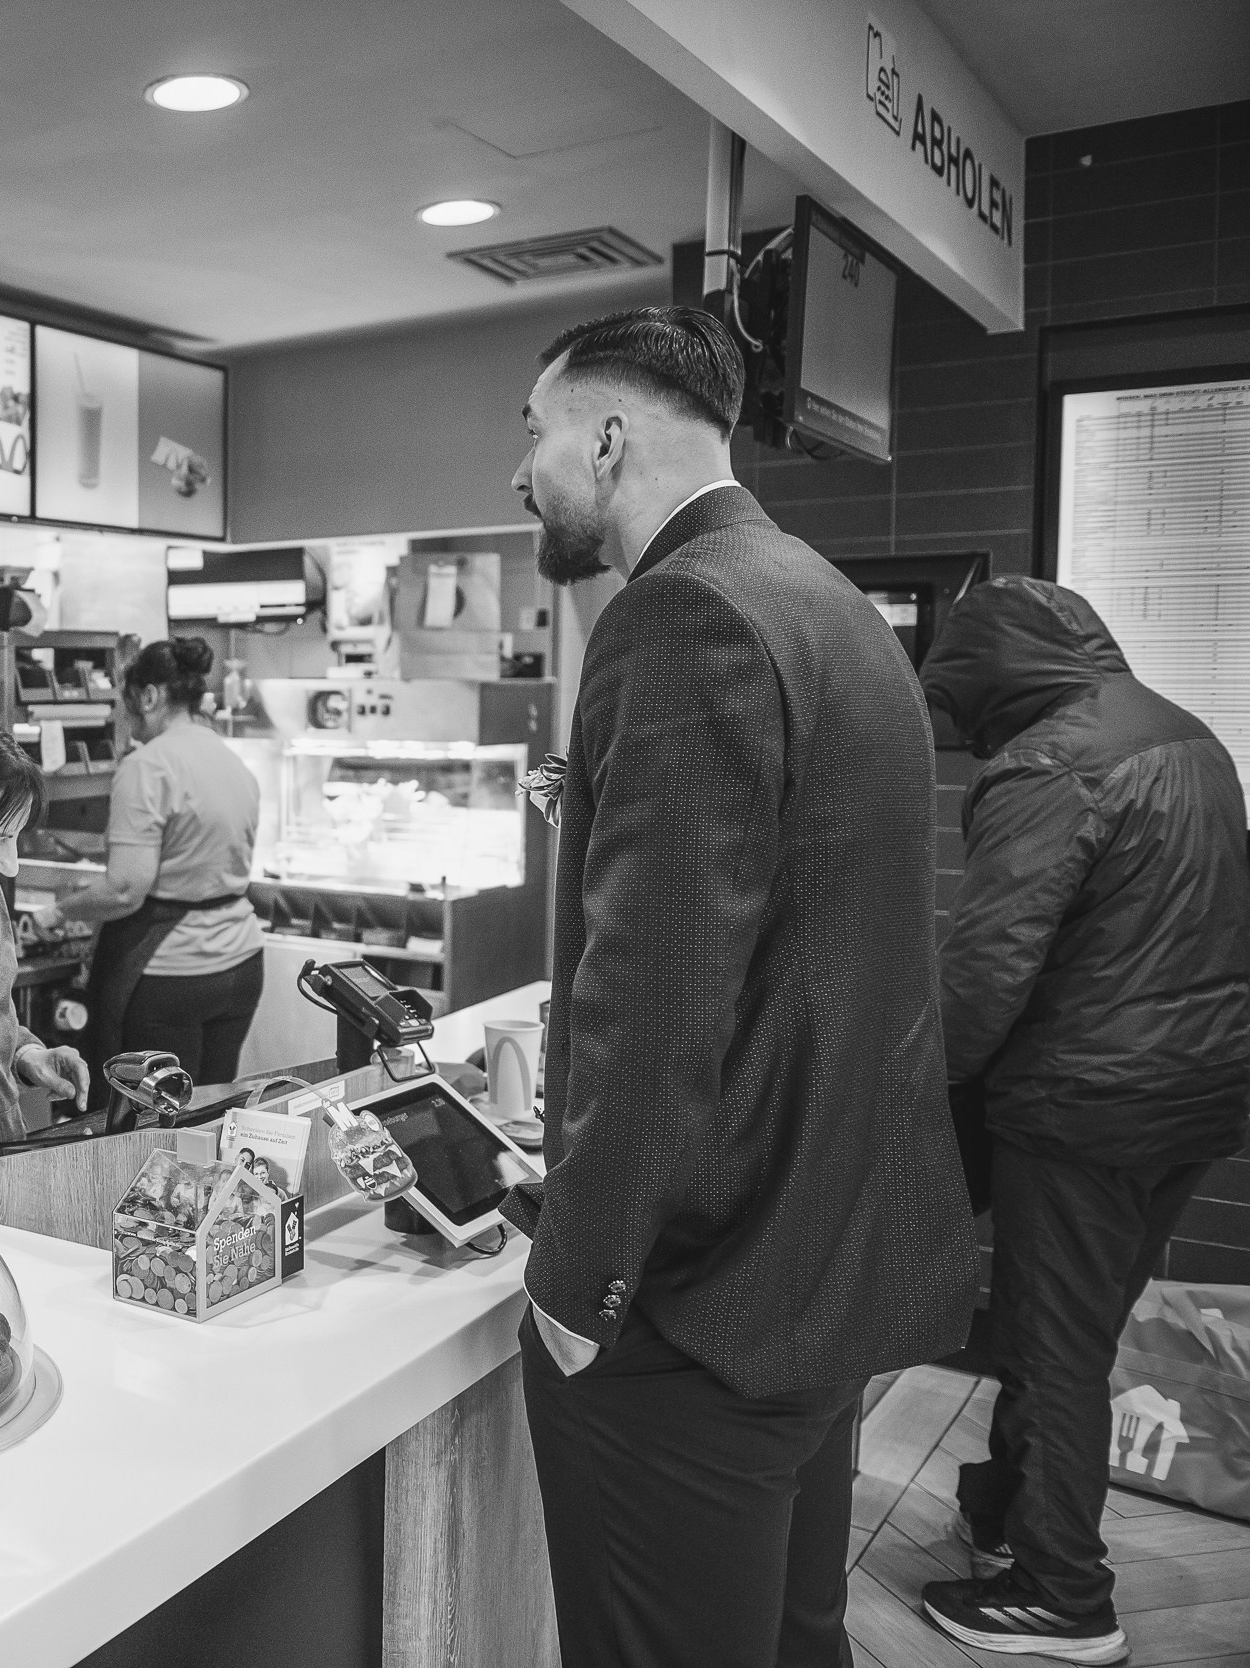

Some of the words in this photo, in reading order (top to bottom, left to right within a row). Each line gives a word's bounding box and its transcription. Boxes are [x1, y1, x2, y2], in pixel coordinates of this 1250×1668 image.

[911, 92, 1013, 248] ABHOLEN
[213, 1225, 257, 1253] Spenden
[213, 1253, 229, 1268] Sie
